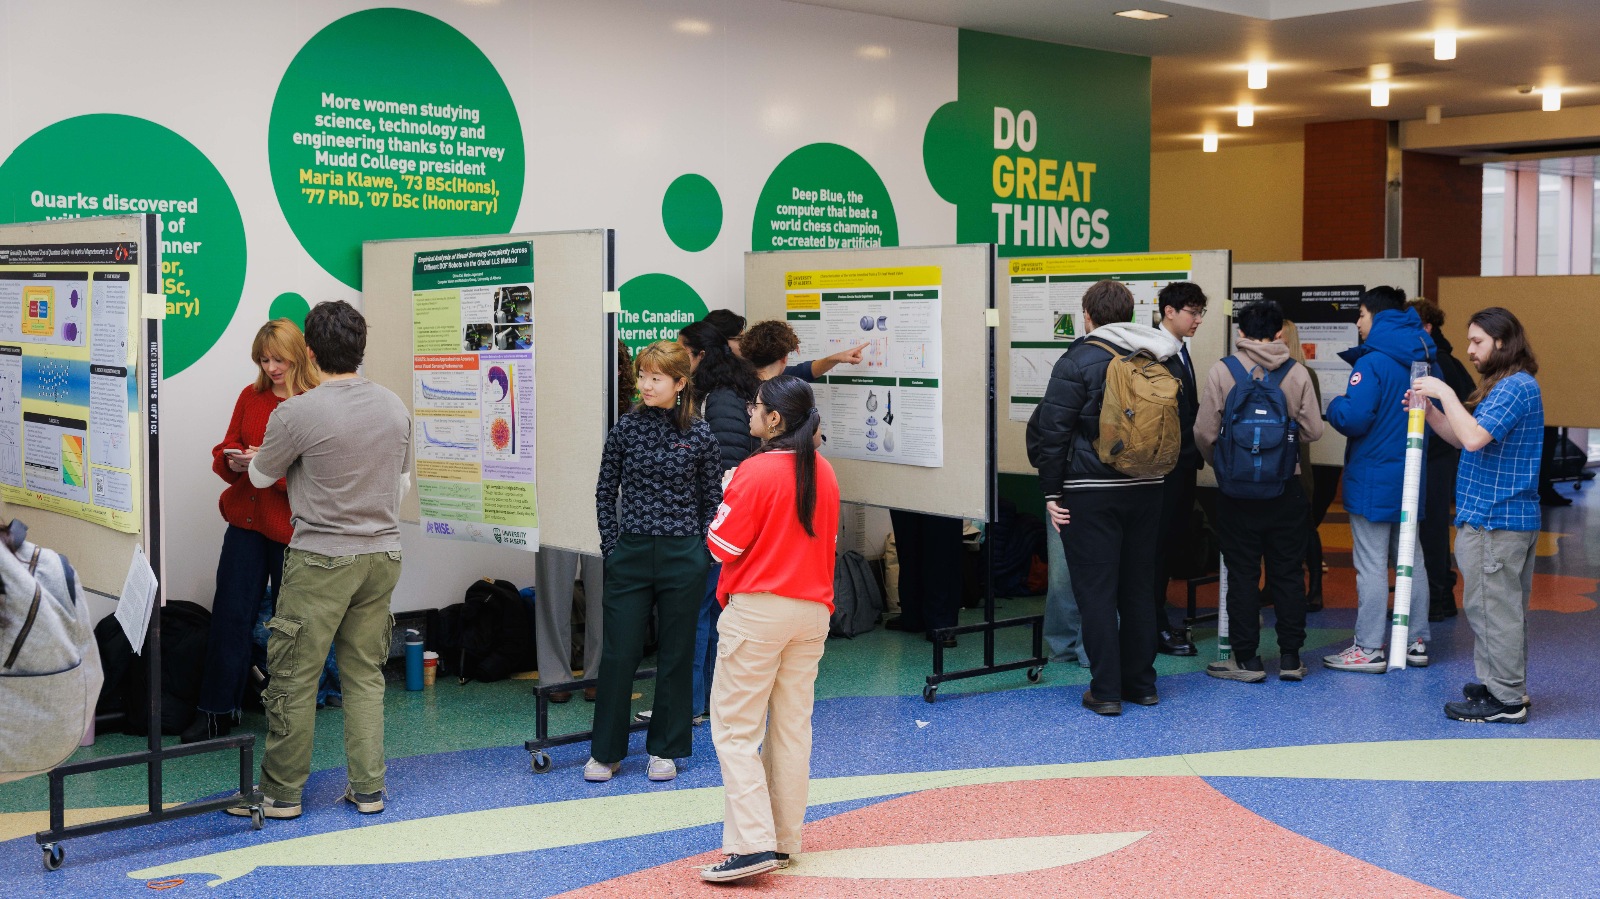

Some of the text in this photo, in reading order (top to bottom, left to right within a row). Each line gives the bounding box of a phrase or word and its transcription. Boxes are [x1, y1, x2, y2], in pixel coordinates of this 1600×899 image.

[322, 92, 479, 123] More women studying
[315, 113, 485, 140] science, technology and
[994, 106, 1037, 152] DO
[292, 132, 505, 162] engineering thanks to Harvey
[316, 150, 486, 176] Mudd College president
[300, 168, 344, 186] Maria
[348, 172, 398, 191] Klawe,
[426, 176, 500, 197] BSc(Hons),
[992, 155, 1096, 202] GREAT
[31, 190, 198, 214] Quarks discovered
[329, 190, 364, 208] PhD,
[392, 194, 420, 208] DSc
[423, 194, 498, 215] (Honorary)
[792, 187, 863, 204] Deep Blue, the
[776, 204, 878, 219] computer that beat a
[168, 217, 186, 233] of
[771, 219, 882, 236] world chess champion,
[992, 203, 1110, 248] THINGS
[772, 236, 881, 249] co-created by artificial
[435, 254, 451, 262] Analysis
[500, 256, 517, 264] Method
[619, 310, 695, 323] The Canadian
[618, 327, 657, 340] ternet
[434, 522, 450, 535] RISE
